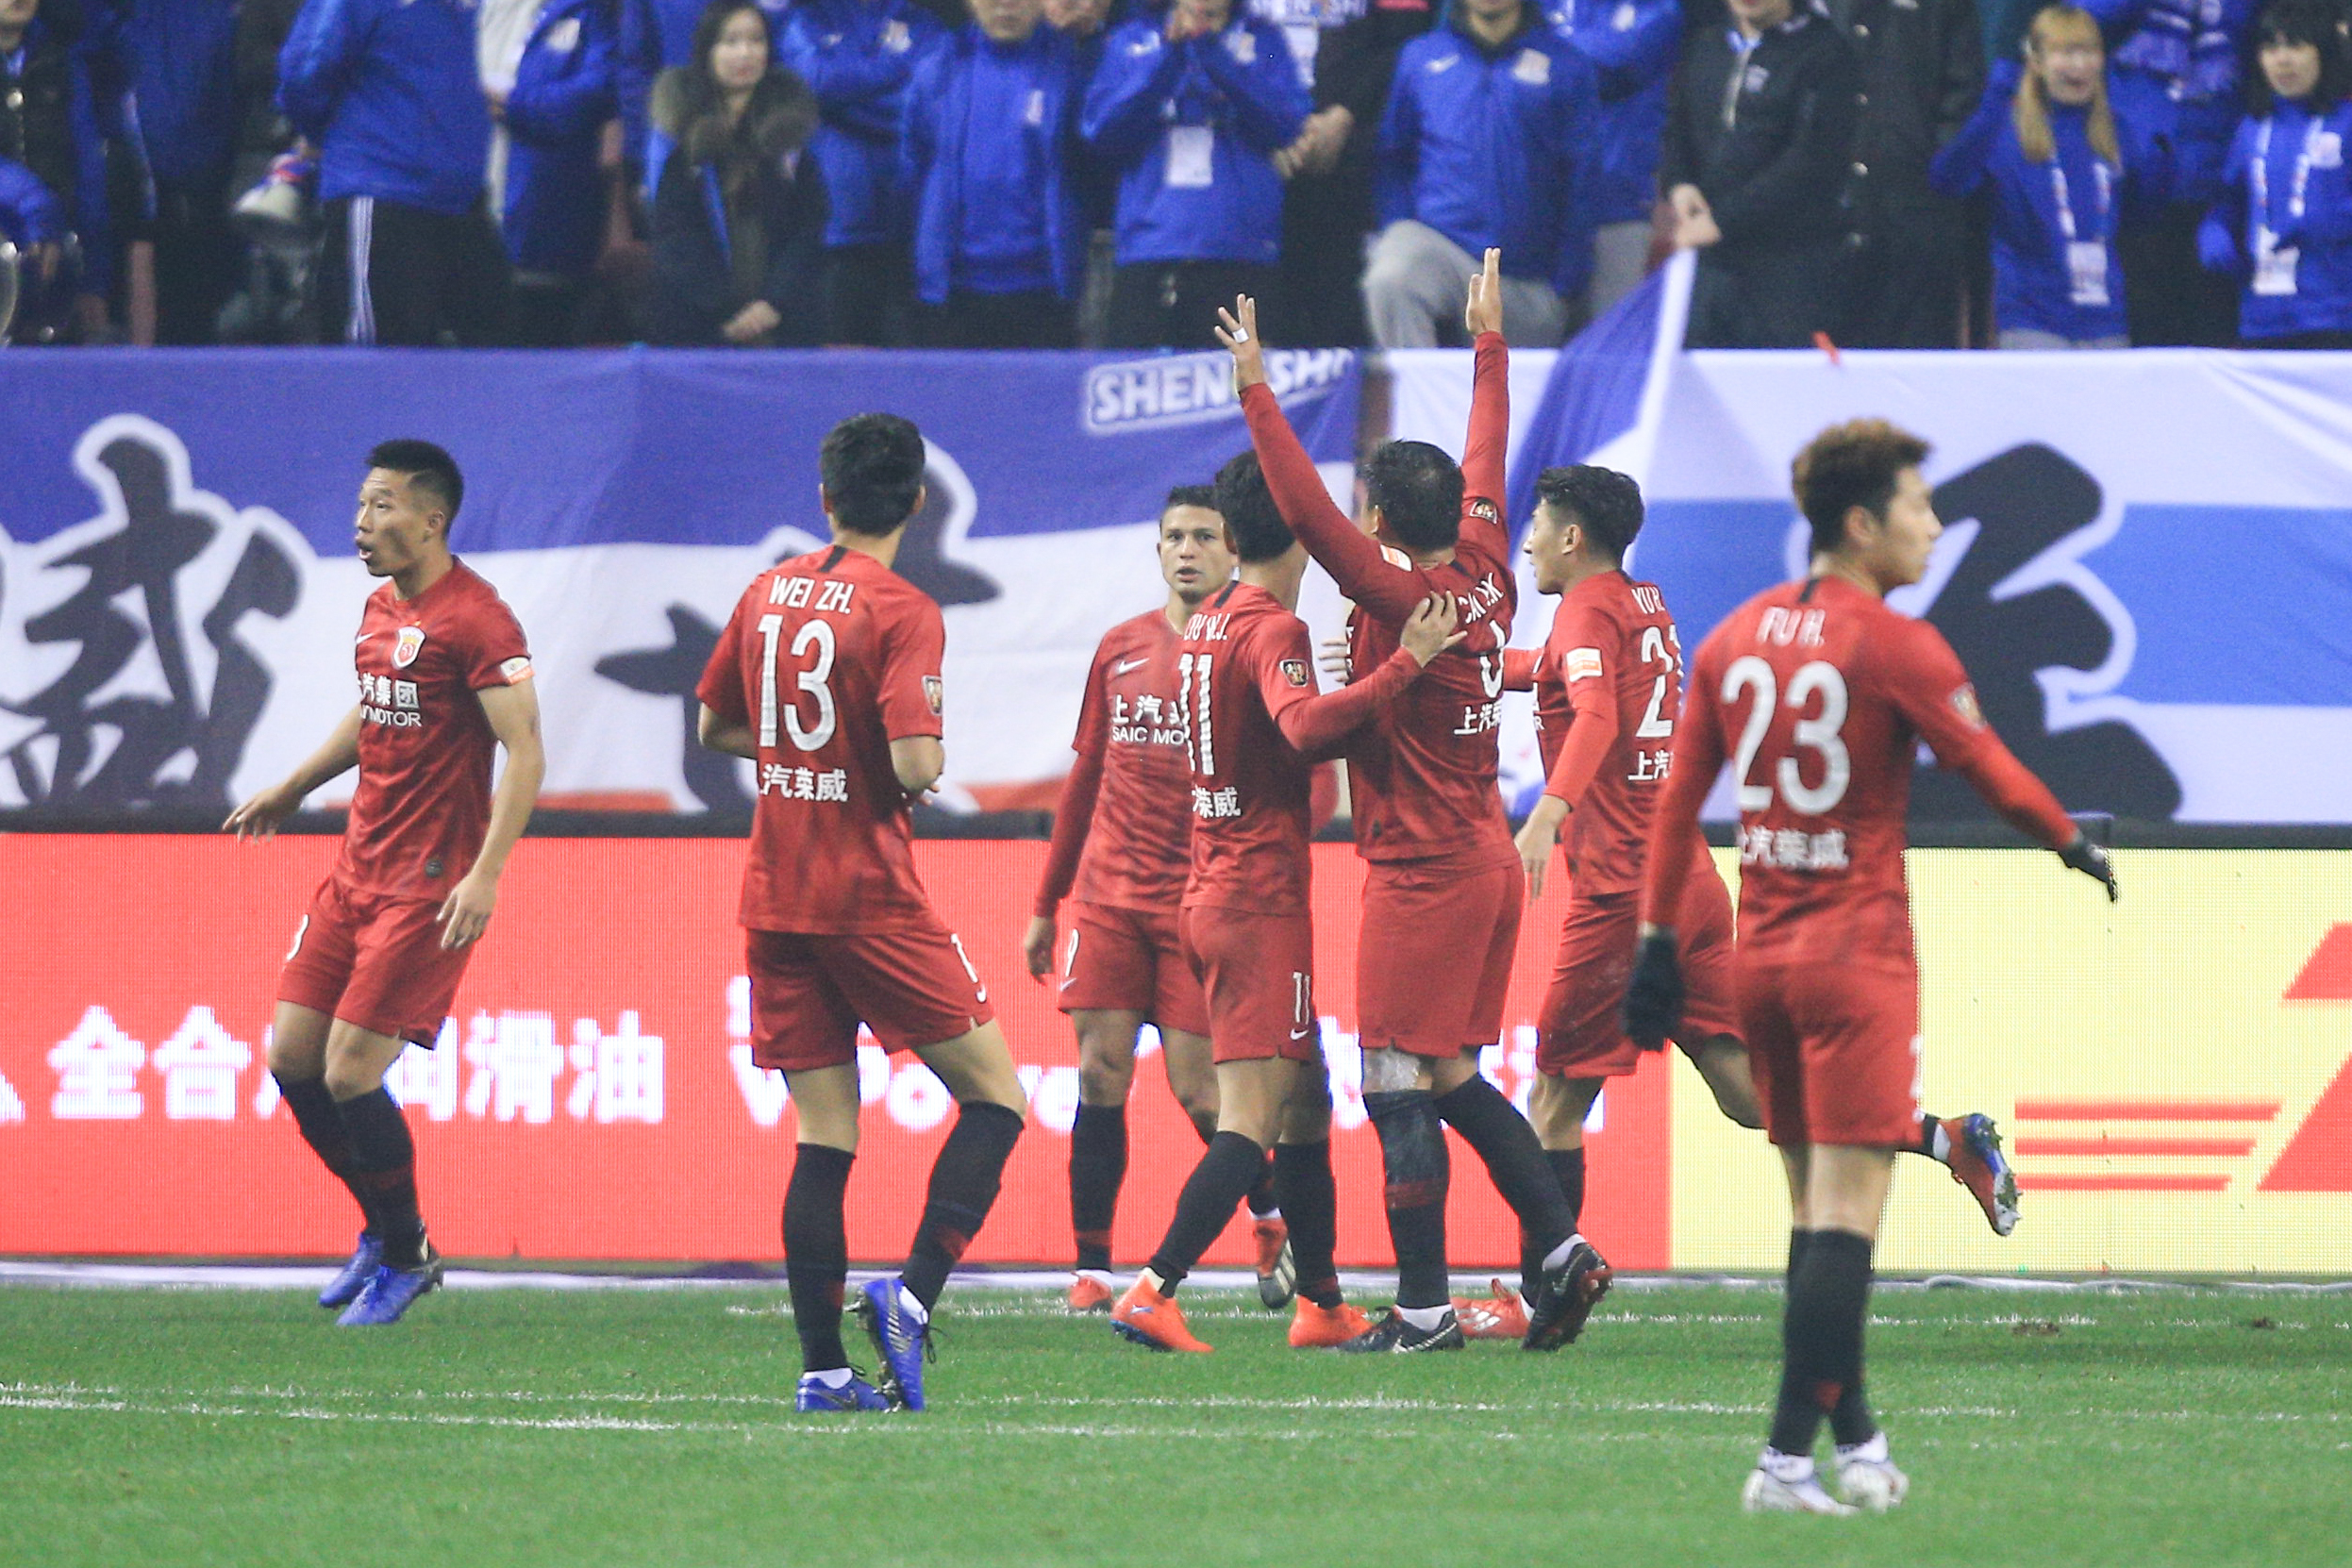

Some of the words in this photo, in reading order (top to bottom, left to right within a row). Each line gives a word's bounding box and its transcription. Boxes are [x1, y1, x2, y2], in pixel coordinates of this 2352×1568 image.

[769, 575, 814, 608] WEI
[814, 580, 854, 614] ZH.
[1756, 606, 1803, 647] FU
[357, 671, 421, 709] 汽集团
[758, 613, 837, 752] 13
[1112, 726, 1148, 742] SAIC
[1179, 653, 1214, 776] 11
[1721, 655, 1851, 815] 23
[760, 762, 849, 803] 汽荣威
[1627, 749, 1675, 781] 上汽
[1191, 783, 1242, 819] 荣威
